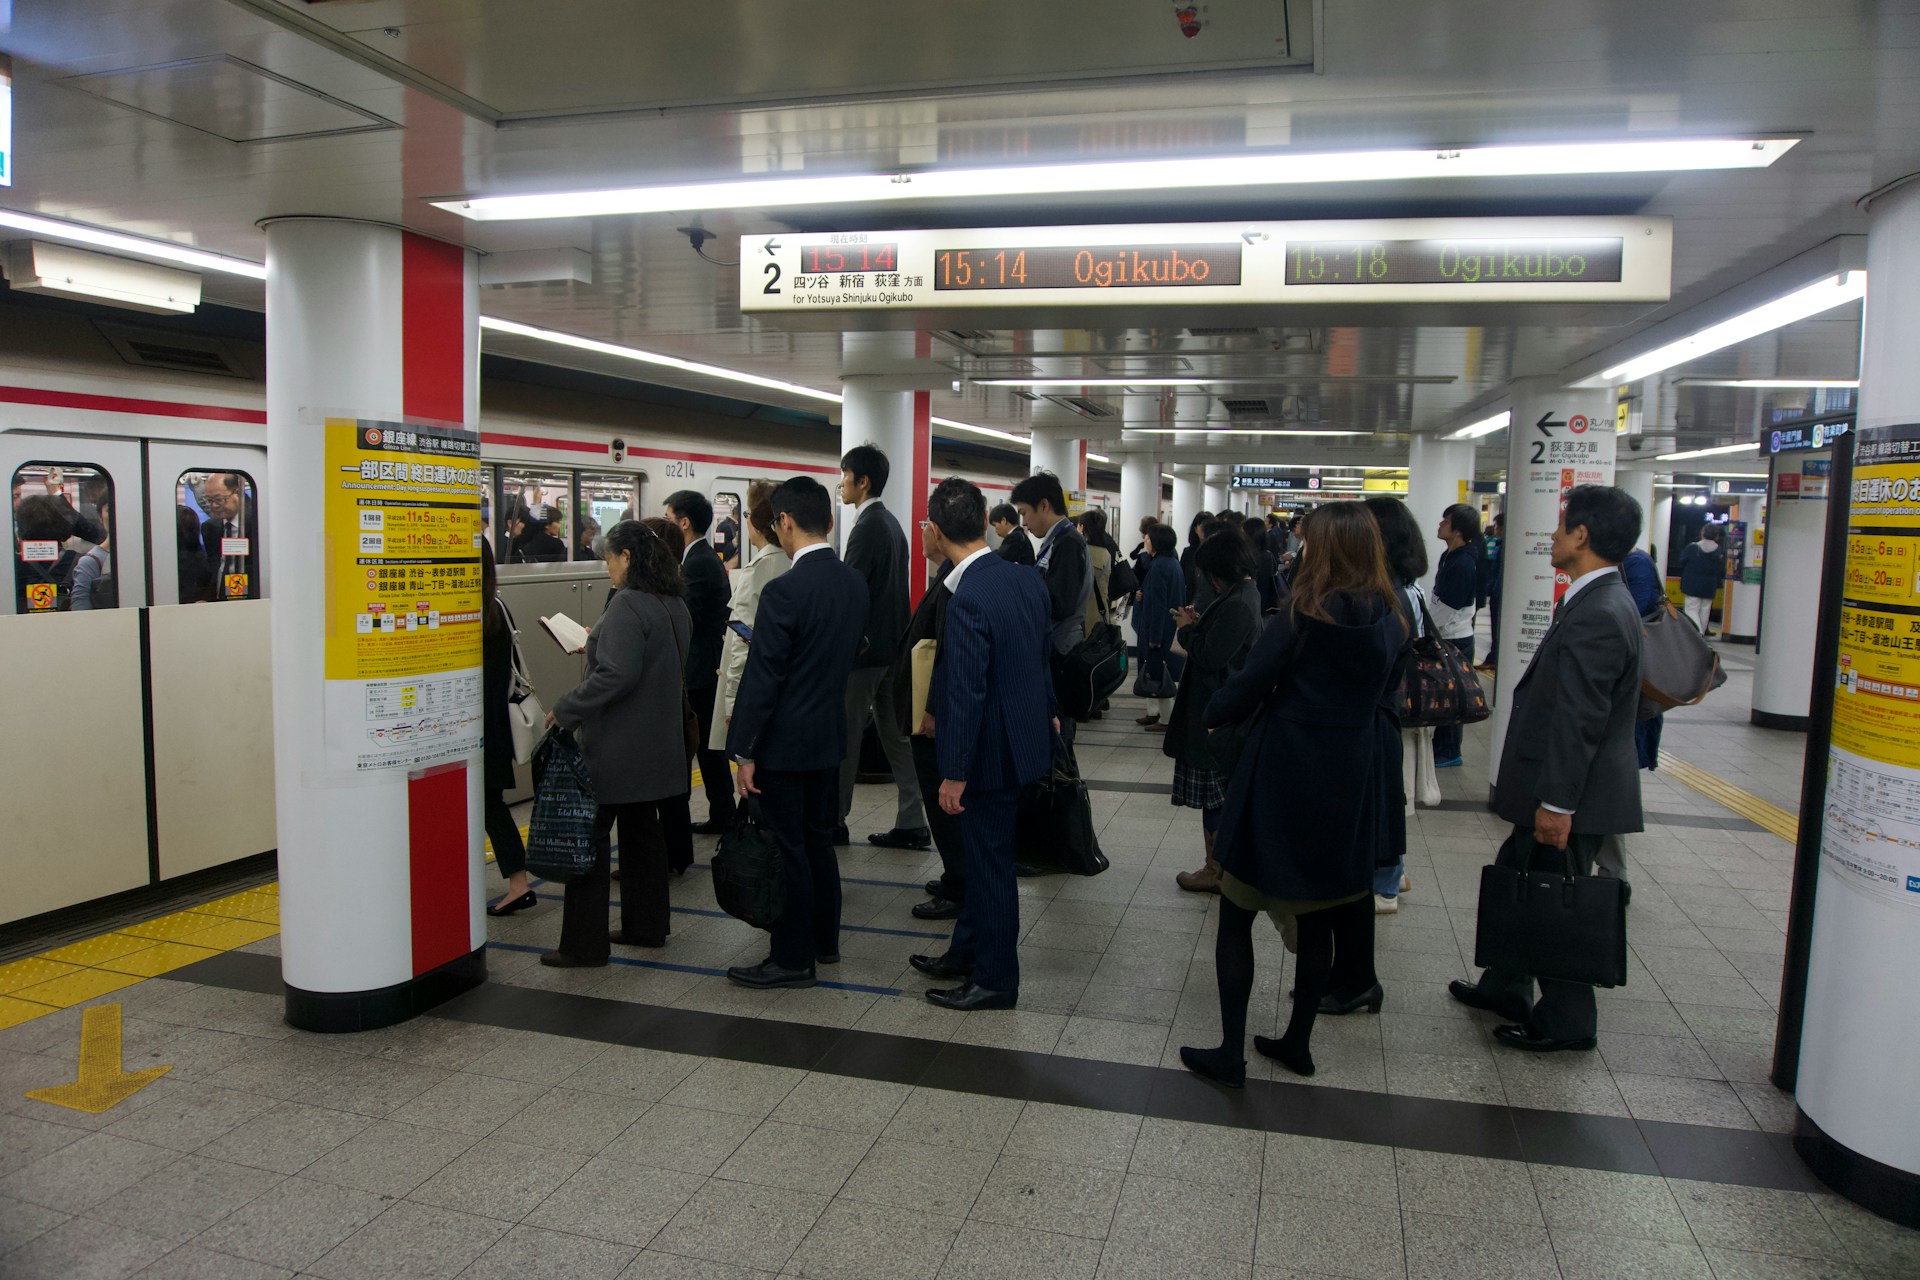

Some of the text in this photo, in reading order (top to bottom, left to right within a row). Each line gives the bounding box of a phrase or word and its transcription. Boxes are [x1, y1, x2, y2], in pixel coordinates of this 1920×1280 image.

[810, 243, 894, 272] 15 14
[1288, 242, 1587, 283] 15:18 Ogikubo
[938, 249, 1210, 287] 15:14 Ogikubo
[763, 262, 781, 295] 2
[793, 272, 924, 289] 四ツ谷 新宿 荻窪 方面
[793, 291, 913, 306] for Yotsuya Shinjuku Ogikubo
[1574, 420, 1584, 428] M
[381, 429, 417, 447] 銀座線
[382, 443, 399, 451] Ginza
[1530, 440, 1546, 464] 2
[1550, 441, 1599, 453] 荻窪方面
[1549, 452, 1590, 461] for Ogikubo
[341, 460, 408, 482] 一部区間
[665, 461, 695, 479] 02214
[1232, 477, 1240, 488] 2
[378, 568, 406, 579] 銀座線
[378, 580, 406, 592] 銀座線
[1529, 599, 1551, 608] 新中野
[1522, 613, 1551, 623] 東高円寺
